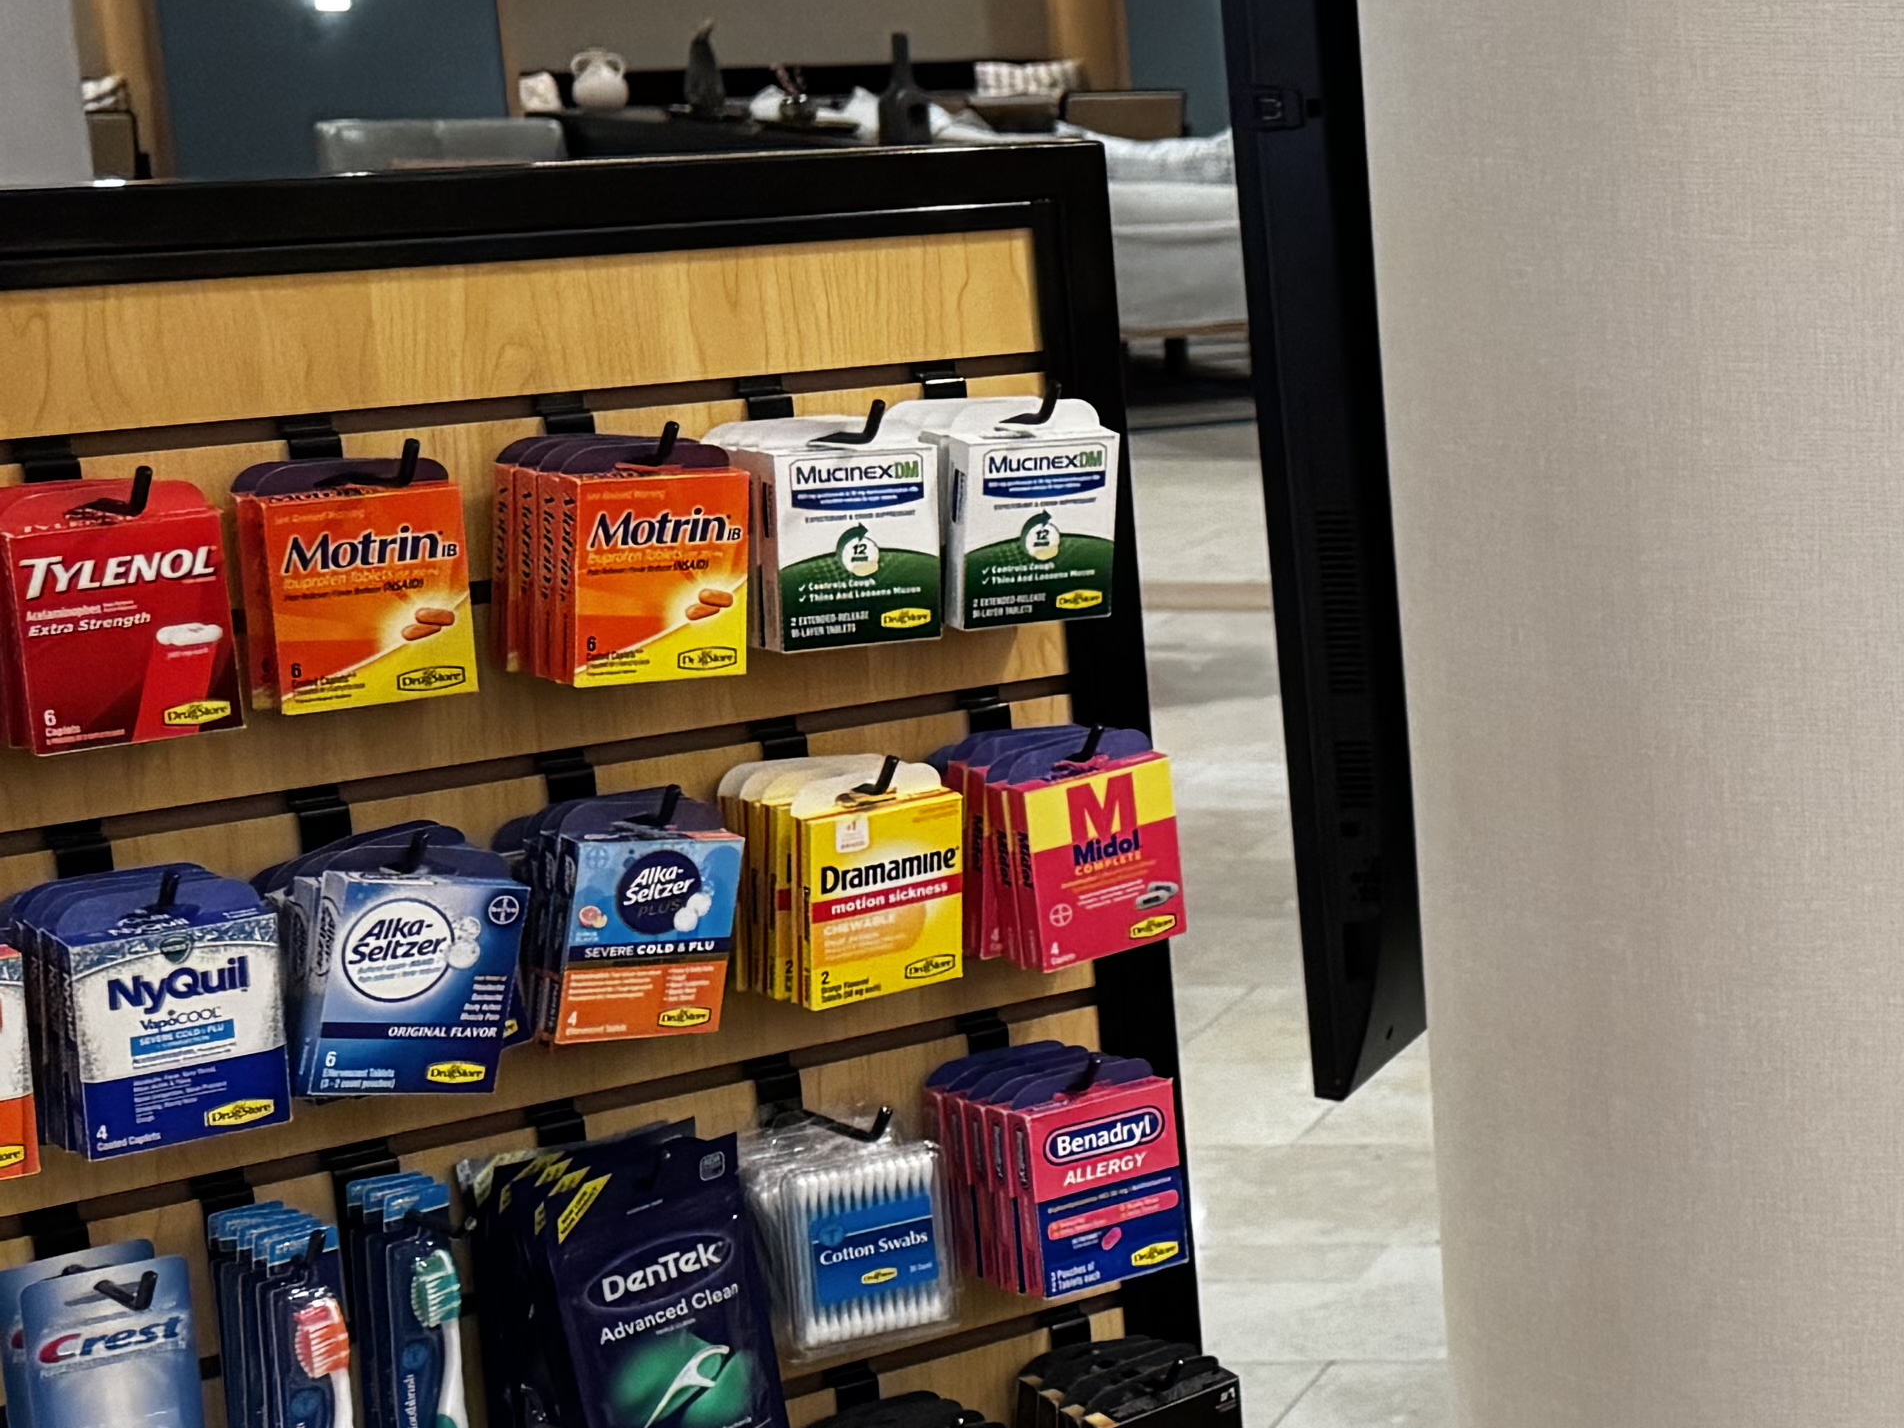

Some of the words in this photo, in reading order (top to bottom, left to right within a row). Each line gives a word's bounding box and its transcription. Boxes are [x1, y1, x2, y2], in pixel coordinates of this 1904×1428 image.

[284, 524, 439, 574] Motrin
[442, 542, 457, 557] IB
[19, 547, 216, 600] TYLENOL
[28, 623, 60, 638] Extra
[65, 612, 150, 635] Strength
[1066, 774, 1138, 840] M
[1072, 834, 1141, 866] Midol
[820, 848, 956, 894] Dramamine
[623, 877, 694, 906] Seltzer
[830, 894, 885, 915] motion
[890, 881, 948, 907] sickness
[348, 934, 446, 964] Seltzer
[584, 945, 634, 958] SEVERE
[638, 943, 672, 956] COLD
[688, 940, 715, 954] FLU
[106, 957, 248, 1014] NyQuil
[388, 1024, 446, 1038] ORIGINAL
[450, 1024, 497, 1038] FLAVOR
[326, 1052, 336, 1067] 6
[1056, 1114, 1153, 1159] Benadryl
[1063, 1154, 1148, 1186] ALLERGY
[819, 1242, 875, 1267] Cotton
[878, 1229, 928, 1251] Swabs
[601, 1244, 724, 1303] DenTek
[599, 1298, 687, 1346] Advanced
[692, 1283, 739, 1311] Clean
[39, 1315, 181, 1364] Crest
